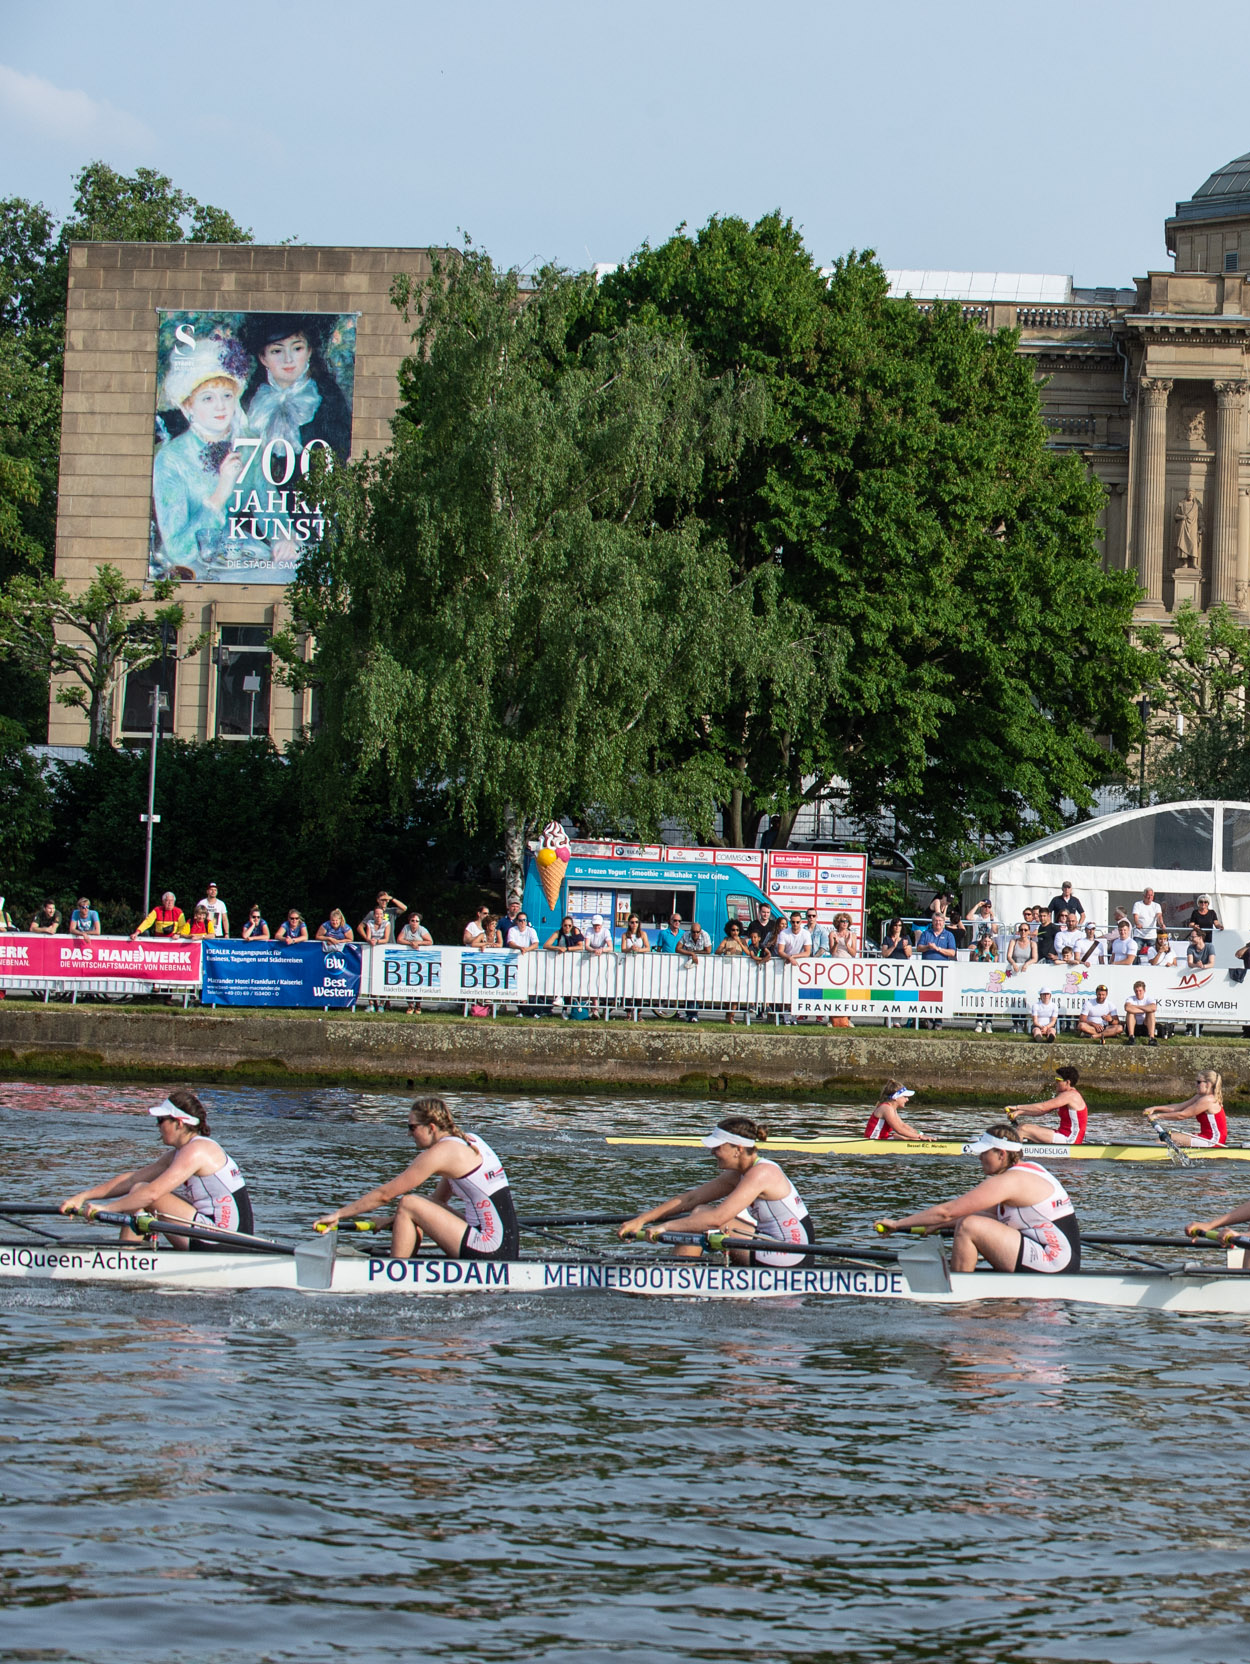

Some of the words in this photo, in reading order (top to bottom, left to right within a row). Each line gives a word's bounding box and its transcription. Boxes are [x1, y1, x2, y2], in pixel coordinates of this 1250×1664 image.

[228, 489, 328, 514] JAHR
[226, 560, 242, 569] DIE
[244, 558, 277, 570] STÄDEL
[608, 868, 626, 876] Yogurt
[60, 948, 93, 960] DAS
[98, 945, 192, 964] HANDWERK
[72, 960, 142, 970] WIRTSCHAFTSMACHT.
[159, 964, 192, 972] NEBENAN.
[383, 960, 442, 987] BBF
[459, 962, 518, 989] BBF
[798, 962, 948, 988] SPORTSTADT
[324, 977, 347, 988] Best
[798, 1003, 876, 1012] FRANKFURT
[882, 1004, 901, 1012] AM
[908, 1005, 943, 1014] MAIN
[961, 996, 984, 1008] TITUS
[990, 996, 1027, 1008] THERMEN
[1164, 1000, 1204, 1008] SYSTEM
[1208, 1000, 1238, 1010] GMBH
[0, 1248, 158, 1270] elQueen-Achter
[368, 1259, 510, 1286] POTSDAM
[544, 1264, 902, 1294] MEINEBOOTSVERSICHERUNG.DE
